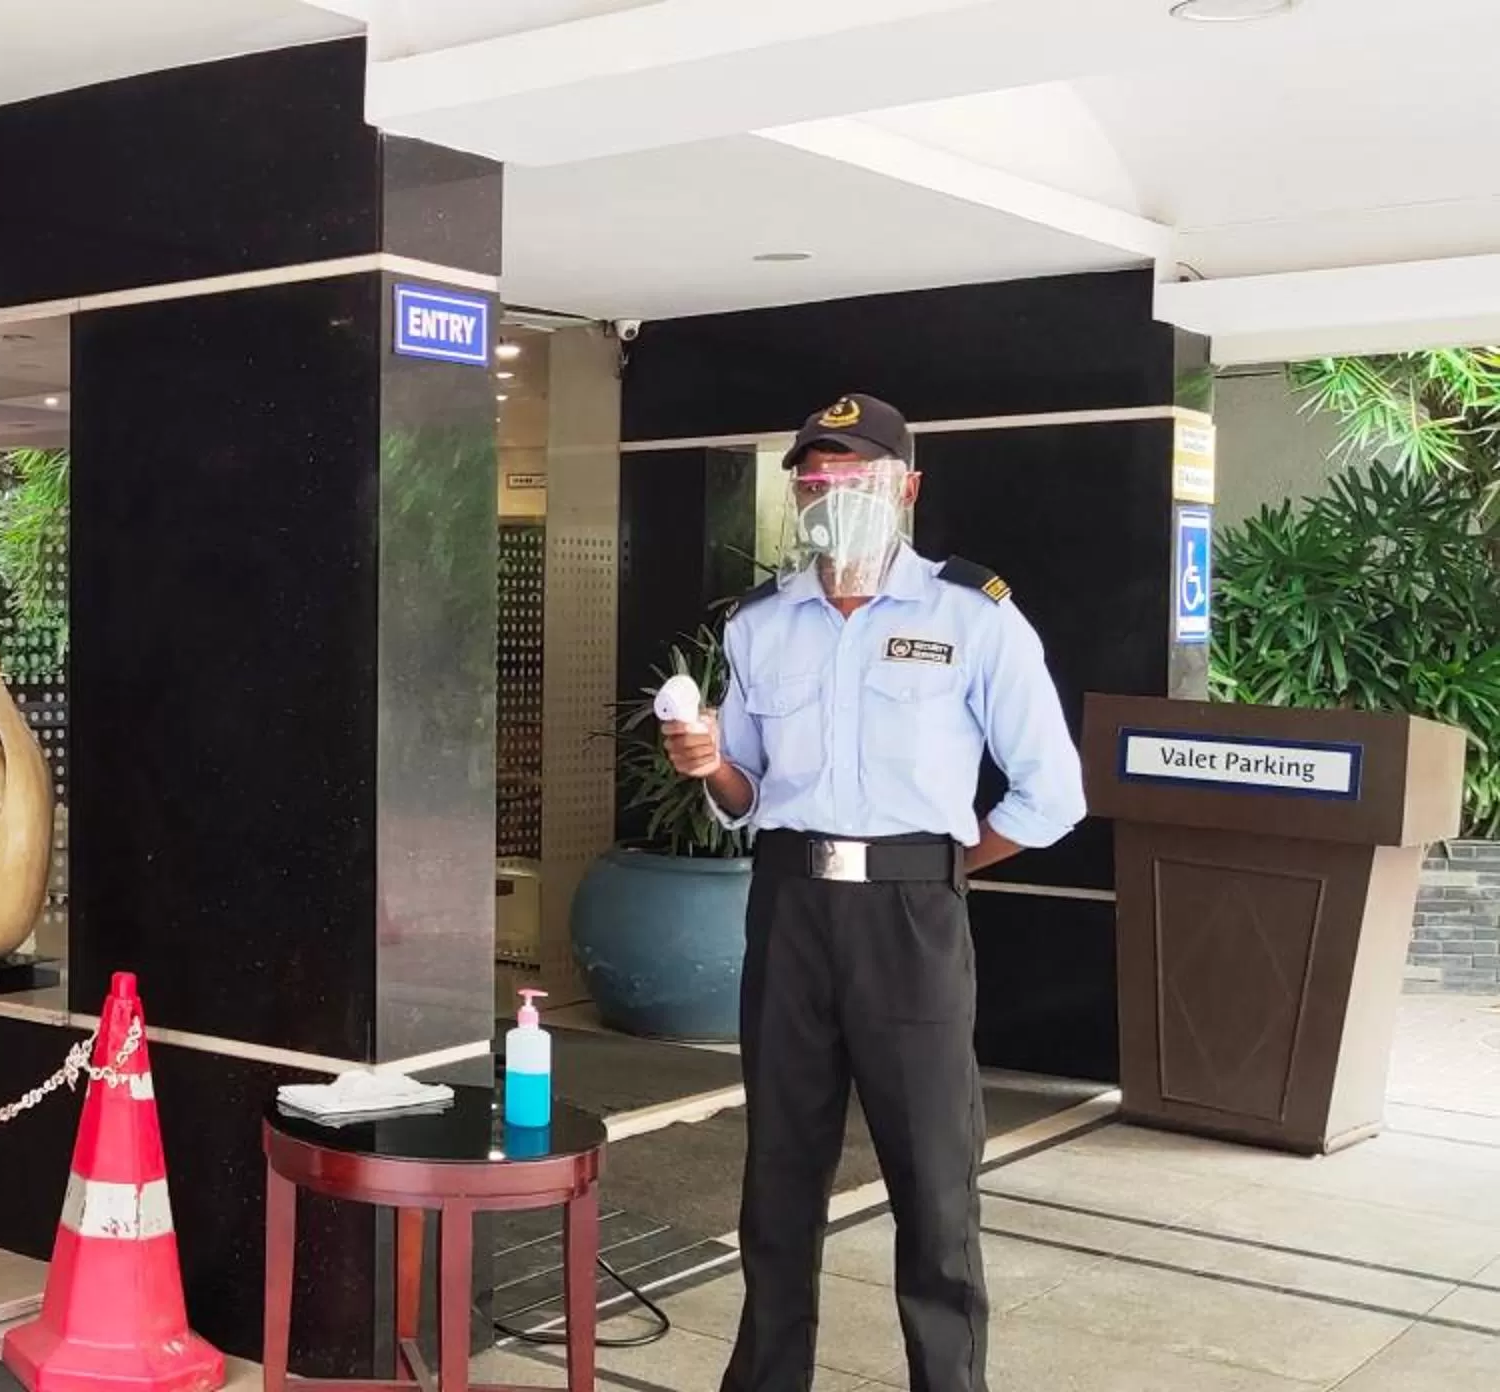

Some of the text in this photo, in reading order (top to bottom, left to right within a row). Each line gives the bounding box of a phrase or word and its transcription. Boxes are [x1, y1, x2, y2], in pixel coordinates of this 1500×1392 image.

[408, 305, 476, 345] ENTRY
[1160, 746, 1316, 783] Valet Parking
